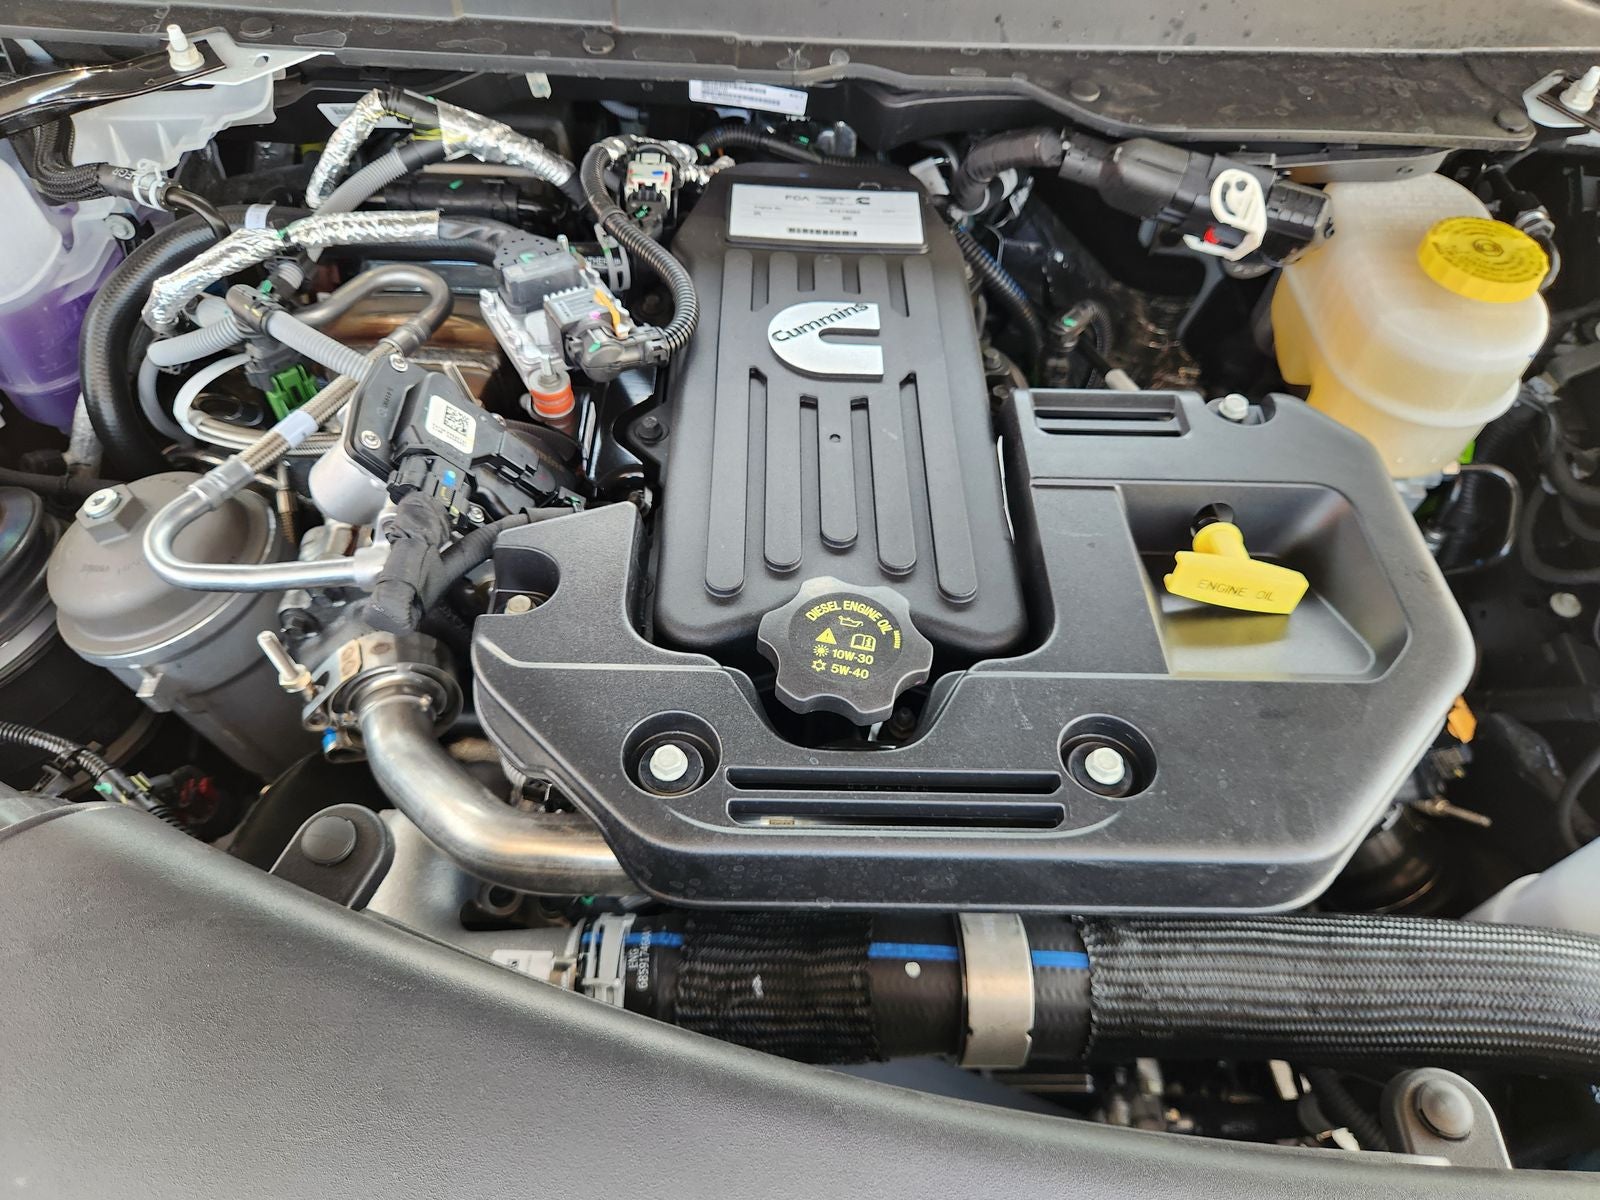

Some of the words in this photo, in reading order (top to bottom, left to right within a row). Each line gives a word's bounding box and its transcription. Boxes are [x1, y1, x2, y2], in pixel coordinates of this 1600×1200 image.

[771, 302, 869, 342] Cummins
[1199, 579, 1248, 598] ENGINE
[1256, 590, 1277, 602] OIL
[805, 600, 842, 621] DIESEL
[843, 600, 883, 622] ENGINE
[877, 619, 903, 635] OIL
[832, 648, 874, 665] 10W-30
[830, 663, 870, 679] 5W-40
